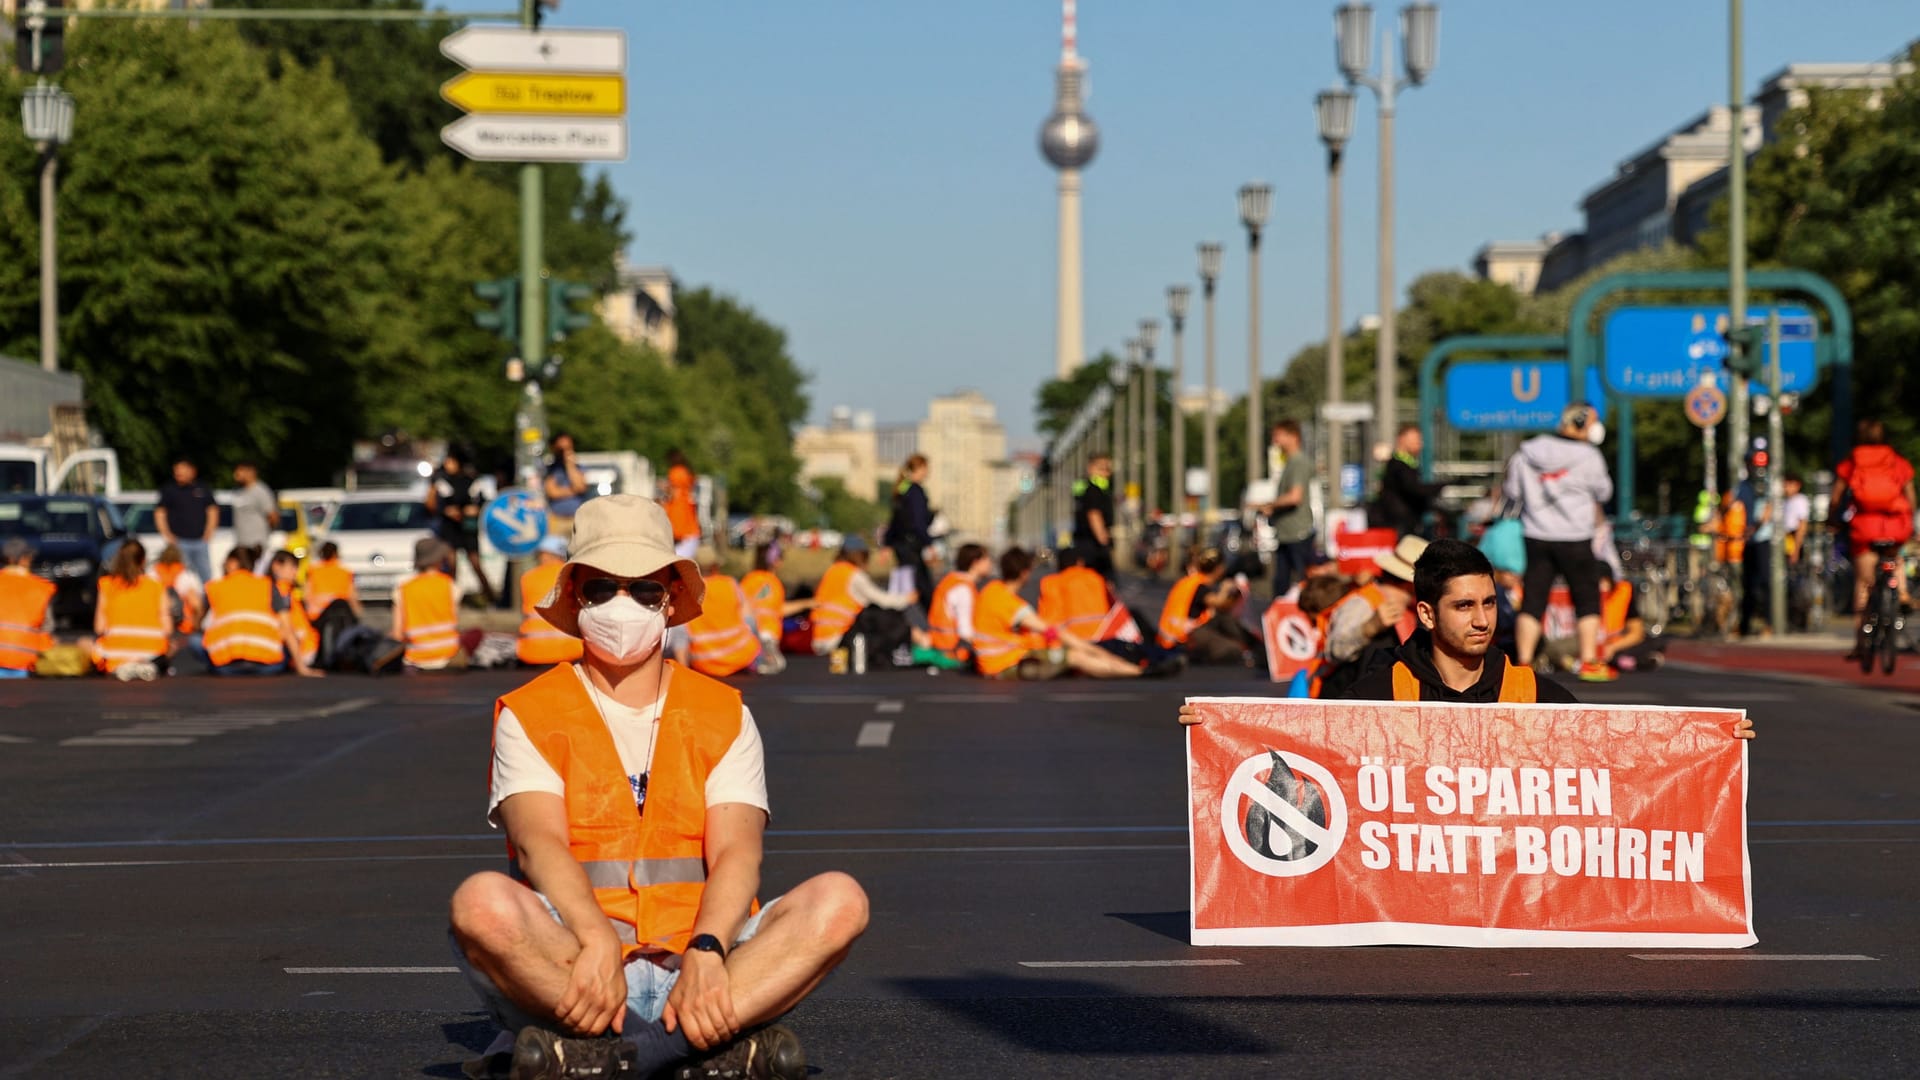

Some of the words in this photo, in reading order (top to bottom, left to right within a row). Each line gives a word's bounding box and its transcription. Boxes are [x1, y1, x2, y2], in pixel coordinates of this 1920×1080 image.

[1511, 366, 1541, 403] U
[1357, 756, 1415, 813] ÖL
[1426, 760, 1612, 816] SPAREN
[1359, 820, 1503, 875] STATT
[1515, 826, 1704, 883] BOHREN
